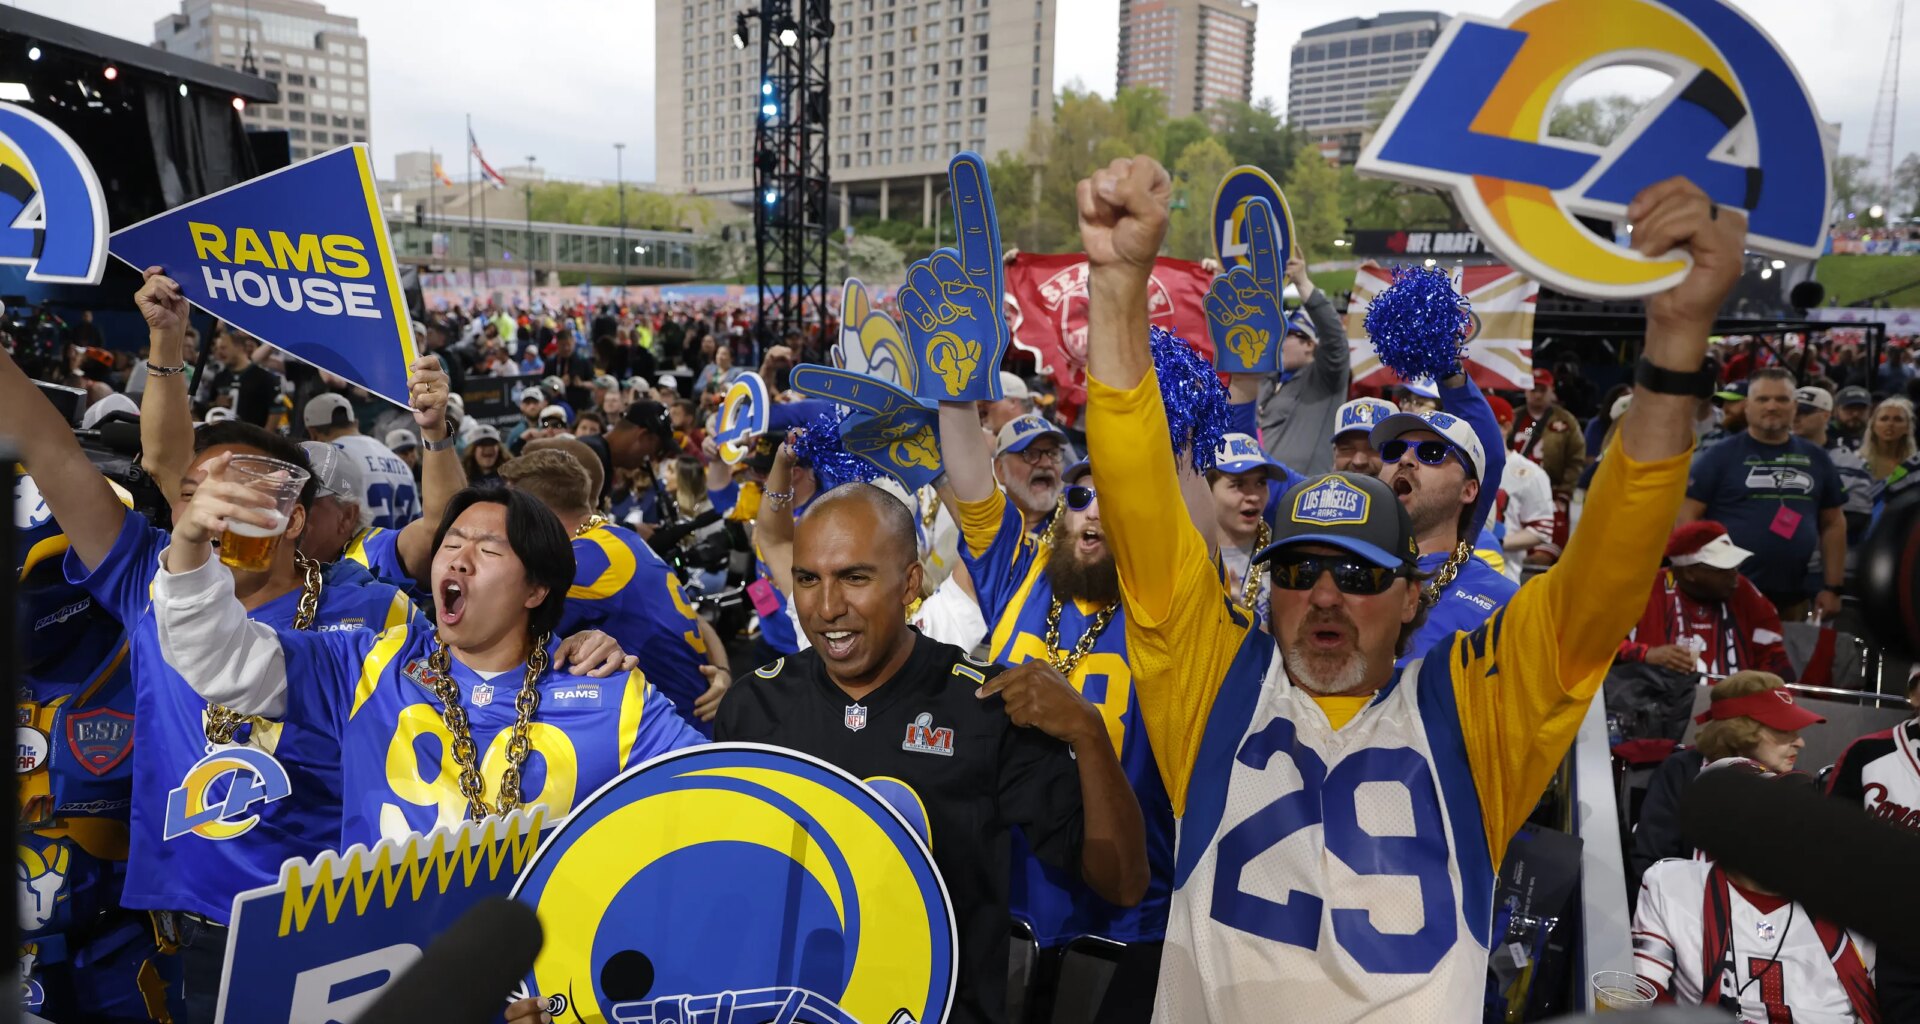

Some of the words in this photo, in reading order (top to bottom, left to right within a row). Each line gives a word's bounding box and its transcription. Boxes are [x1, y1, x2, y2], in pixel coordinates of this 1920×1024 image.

[188, 221, 371, 279] RAMS
[1405, 232, 1431, 253] NFL
[1433, 232, 1479, 253] DRAFT
[201, 265, 382, 319] HOUSE
[1303, 491, 1319, 511] LOS
[1320, 488, 1358, 512] ANGELES
[1317, 508, 1337, 517] RAMS
[1455, 590, 1493, 611] RAMS
[554, 690, 599, 699] RAMS
[847, 715, 865, 727] NFL
[1209, 715, 1458, 975] 29
